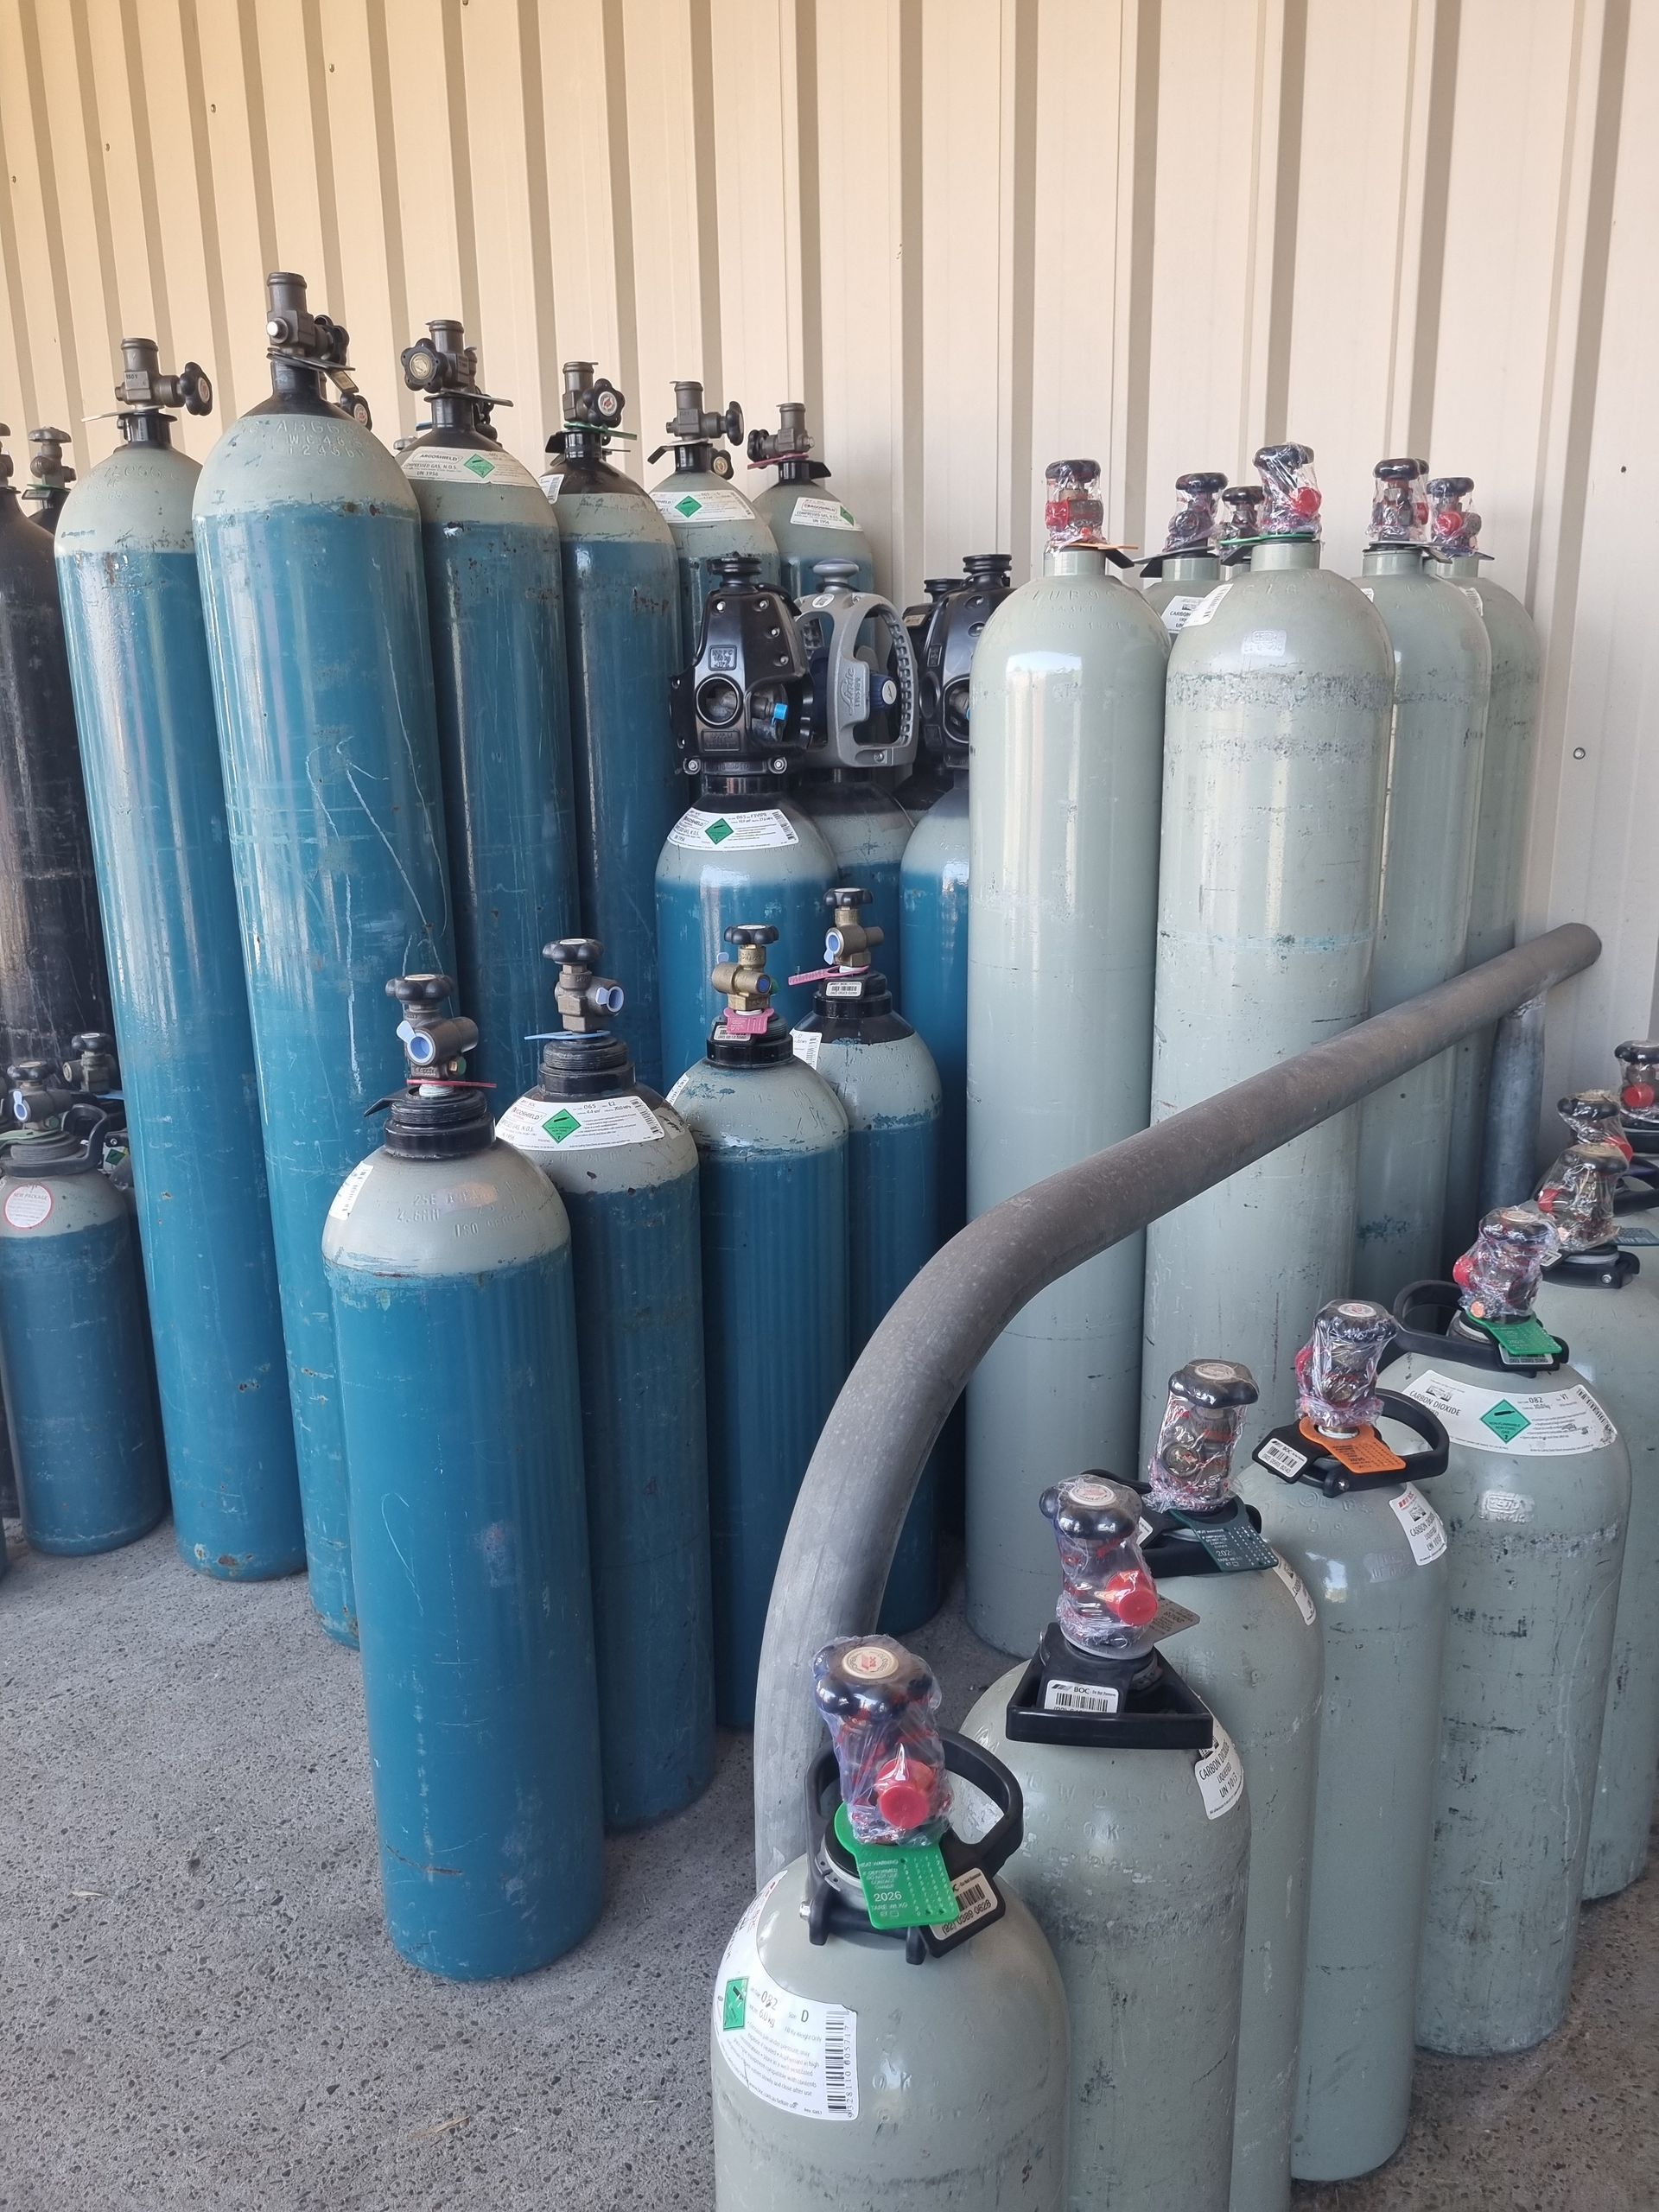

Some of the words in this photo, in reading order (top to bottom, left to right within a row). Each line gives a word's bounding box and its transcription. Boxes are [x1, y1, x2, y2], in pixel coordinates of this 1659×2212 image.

[840, 667, 855, 716] Linde
[1409, 1390, 1433, 1405] CARBON
[1433, 1400, 1461, 1416] DIOXIDE
[1282, 1446, 1293, 1454] BOC
[1409, 1522, 1428, 1537] CARBON
[1074, 1686, 1090, 1694] BOC
[1198, 1757, 1222, 1781] CARBON
[1218, 1783, 1229, 1798] UN
[874, 1891, 902, 1902] 2026
[761, 1991, 778, 2011] 082
[801, 2009, 810, 2023] D
